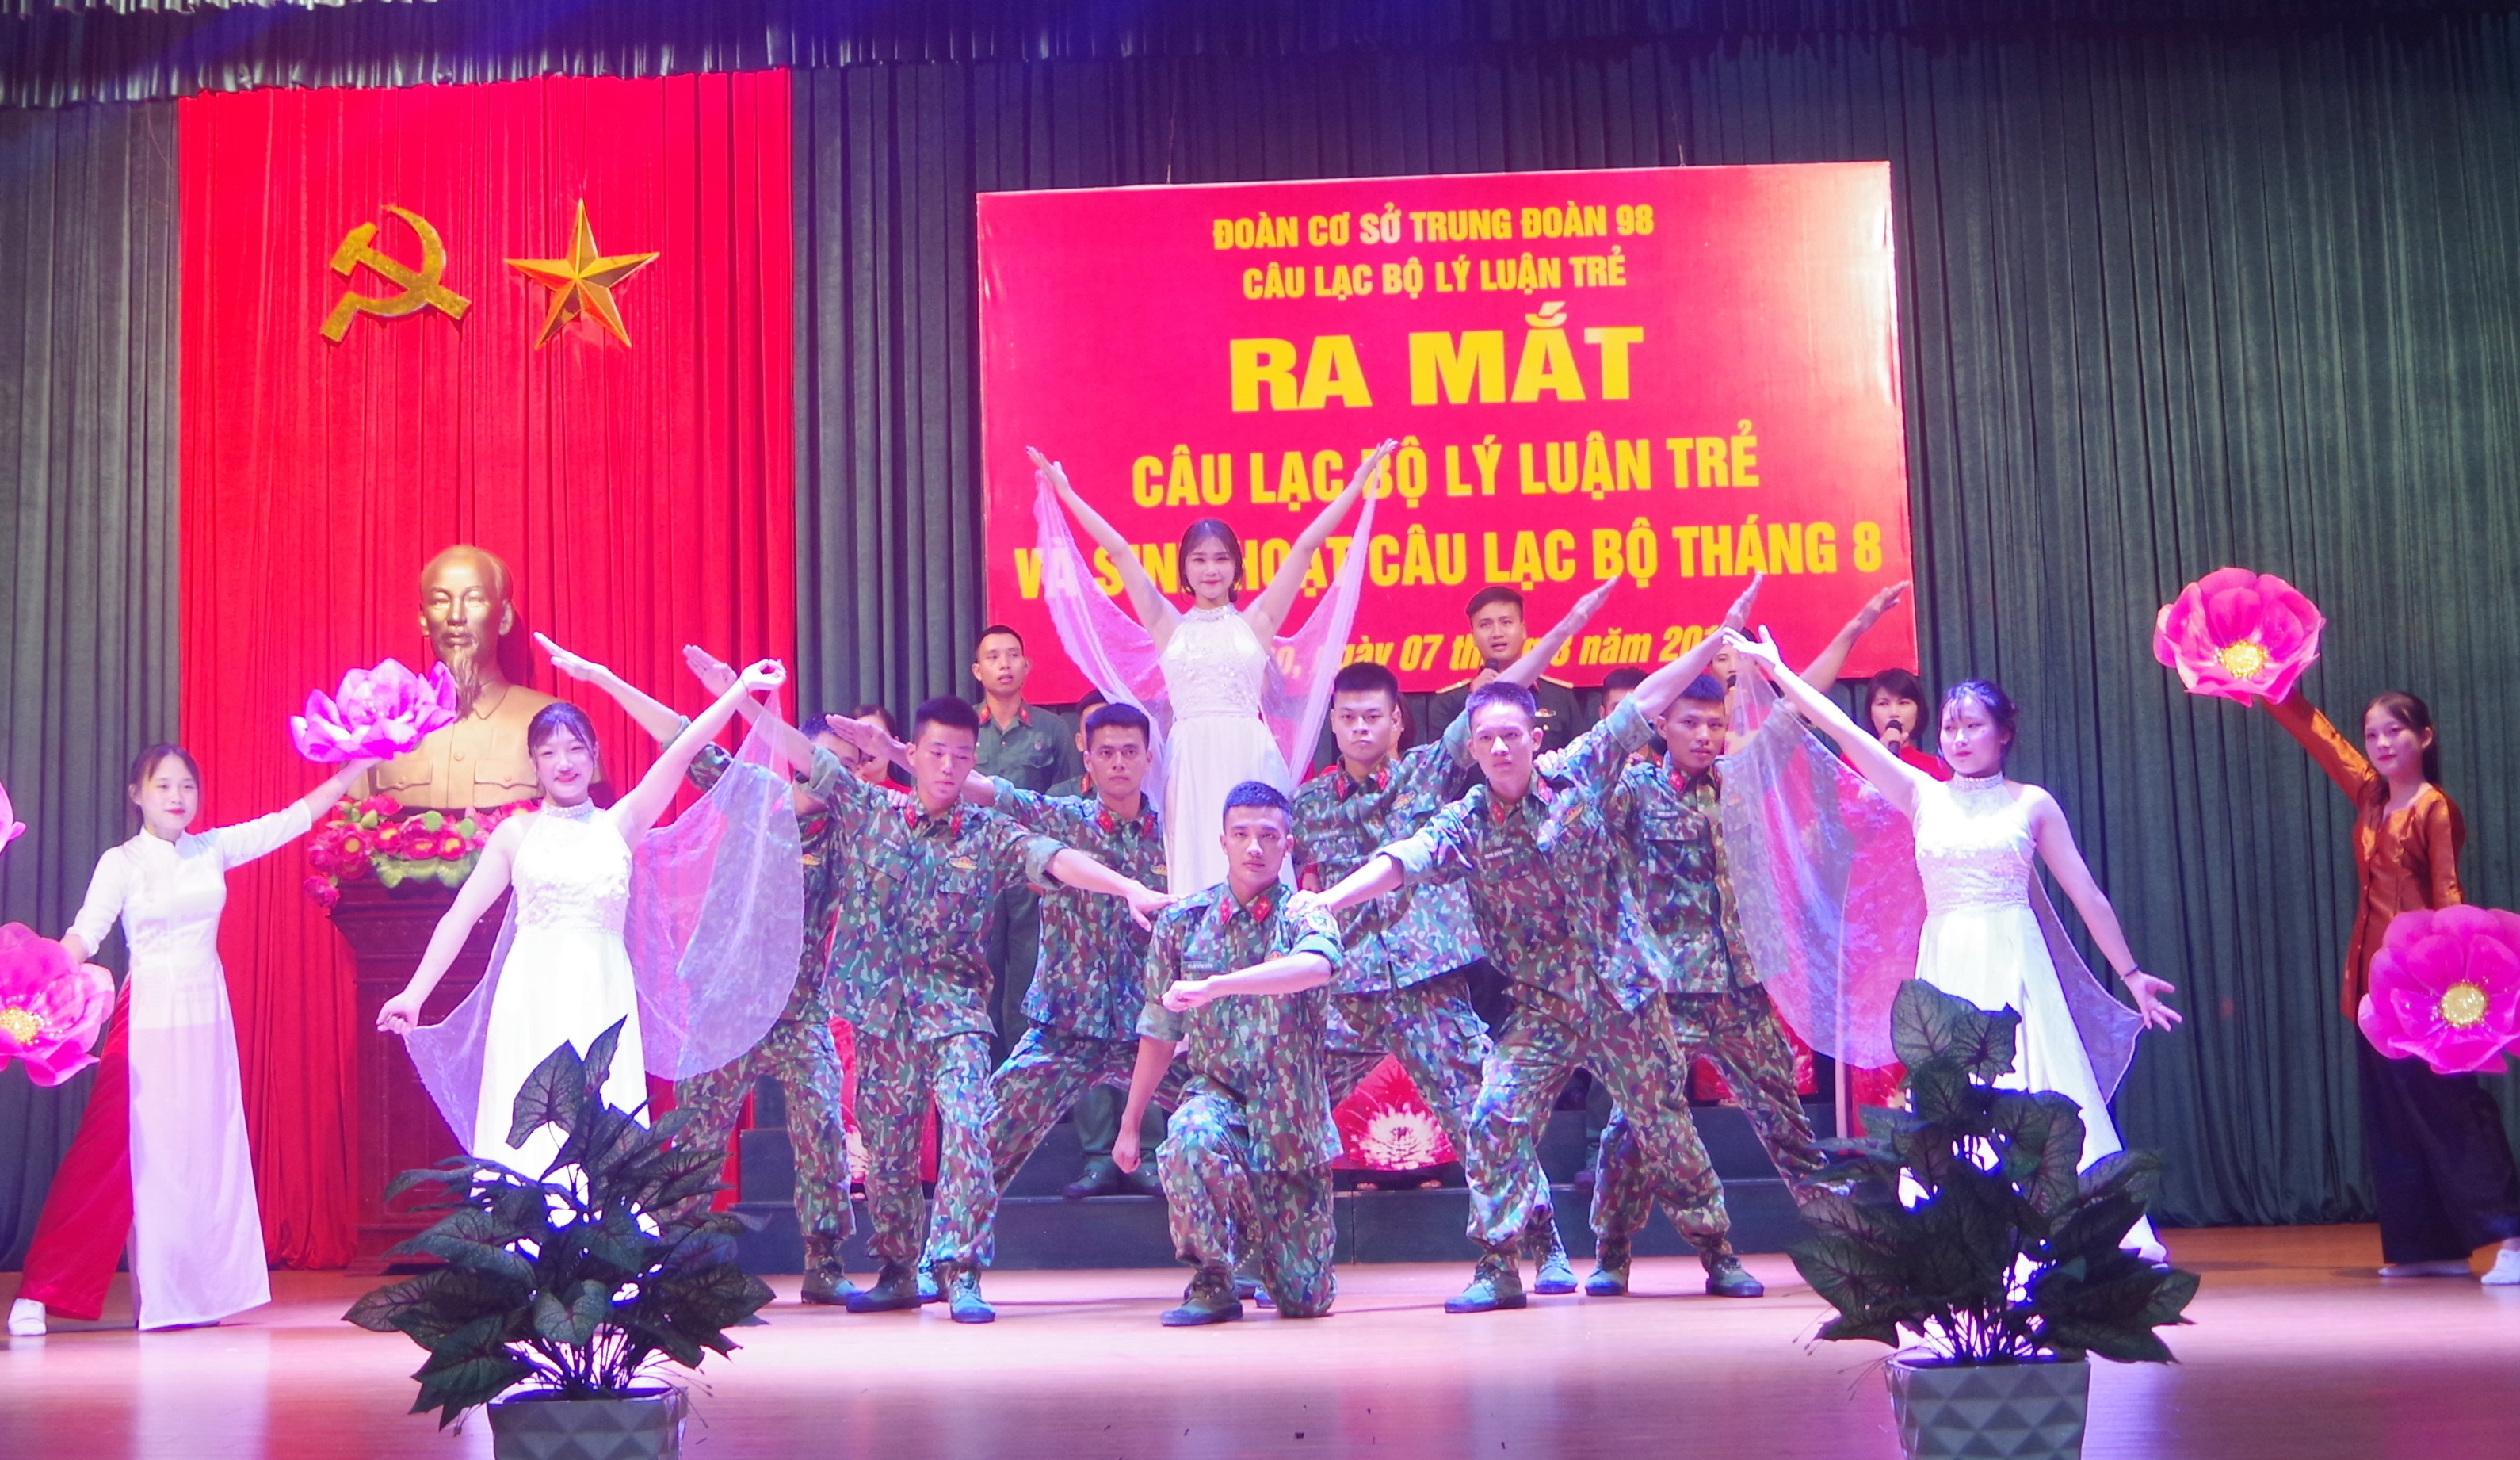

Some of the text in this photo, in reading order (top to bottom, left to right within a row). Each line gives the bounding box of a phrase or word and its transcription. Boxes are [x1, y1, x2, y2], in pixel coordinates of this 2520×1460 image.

[1212, 201, 1654, 250] ĐOÀN CƠ SỞ TRUNG ĐOÀN 98
[1243, 245, 1627, 301] CÂU LẠC BỘ LÝ LUẬN TRẺ
[1230, 301, 1644, 412] RA MẮT
[1132, 418, 1760, 512] CÂU LẠC BỘ LÝ LUẬN TRẺ
[1014, 537, 1078, 599] VÀ
[1369, 523, 1467, 587] CÂU
[1483, 529, 1576, 590] LẠC
[1592, 517, 1658, 588] BỘ
[1671, 514, 1838, 577] THÁNG
[1852, 519, 1884, 573] 8
[1399, 634, 1444, 671] 07
[1579, 628, 1652, 665] năm
